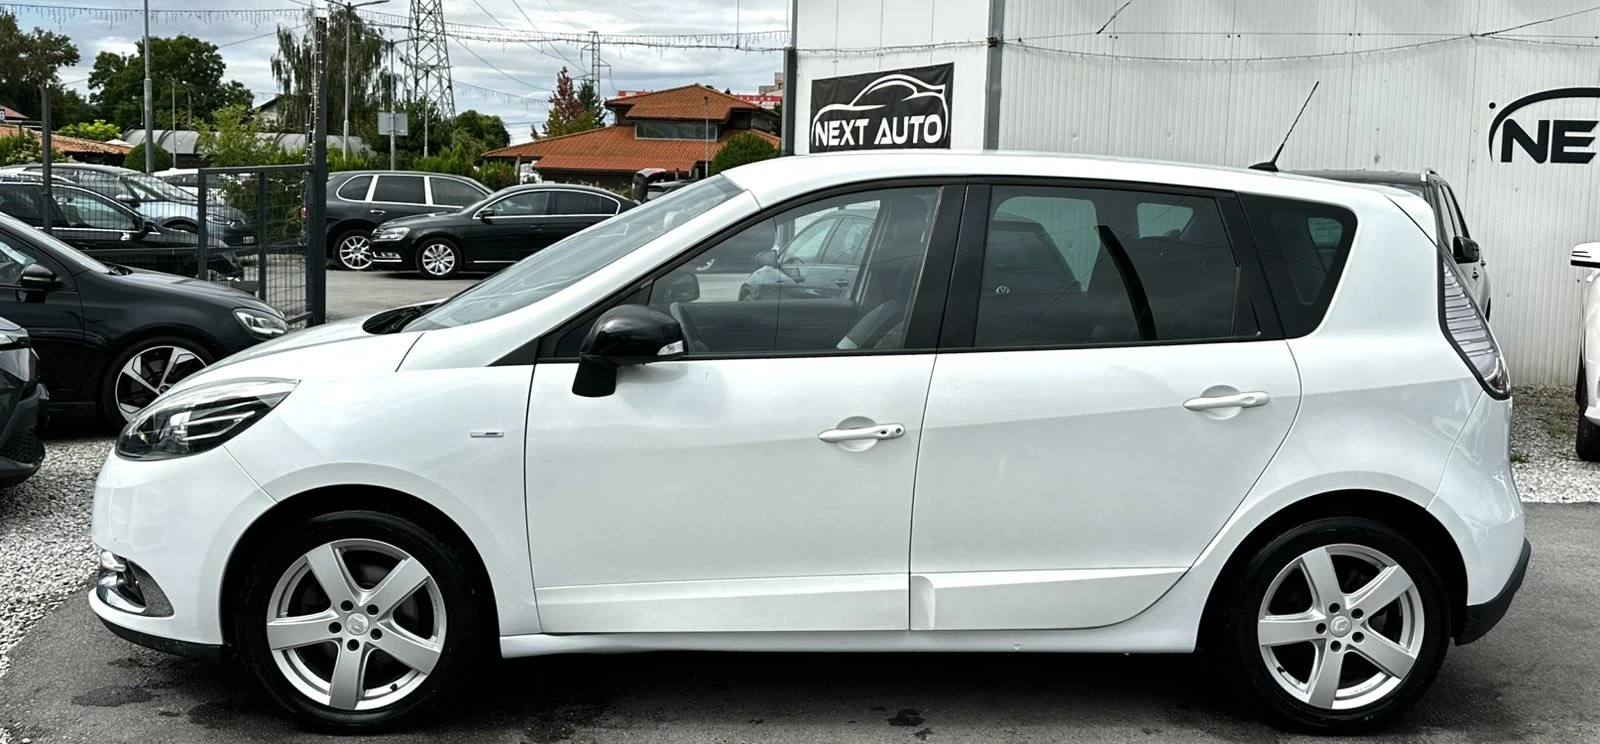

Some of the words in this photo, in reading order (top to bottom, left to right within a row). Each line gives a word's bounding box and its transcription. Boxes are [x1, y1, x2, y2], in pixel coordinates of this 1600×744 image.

[815, 118, 870, 147] NEXT
[874, 114, 943, 145] AUTO
[1501, 118, 1599, 164] NE
